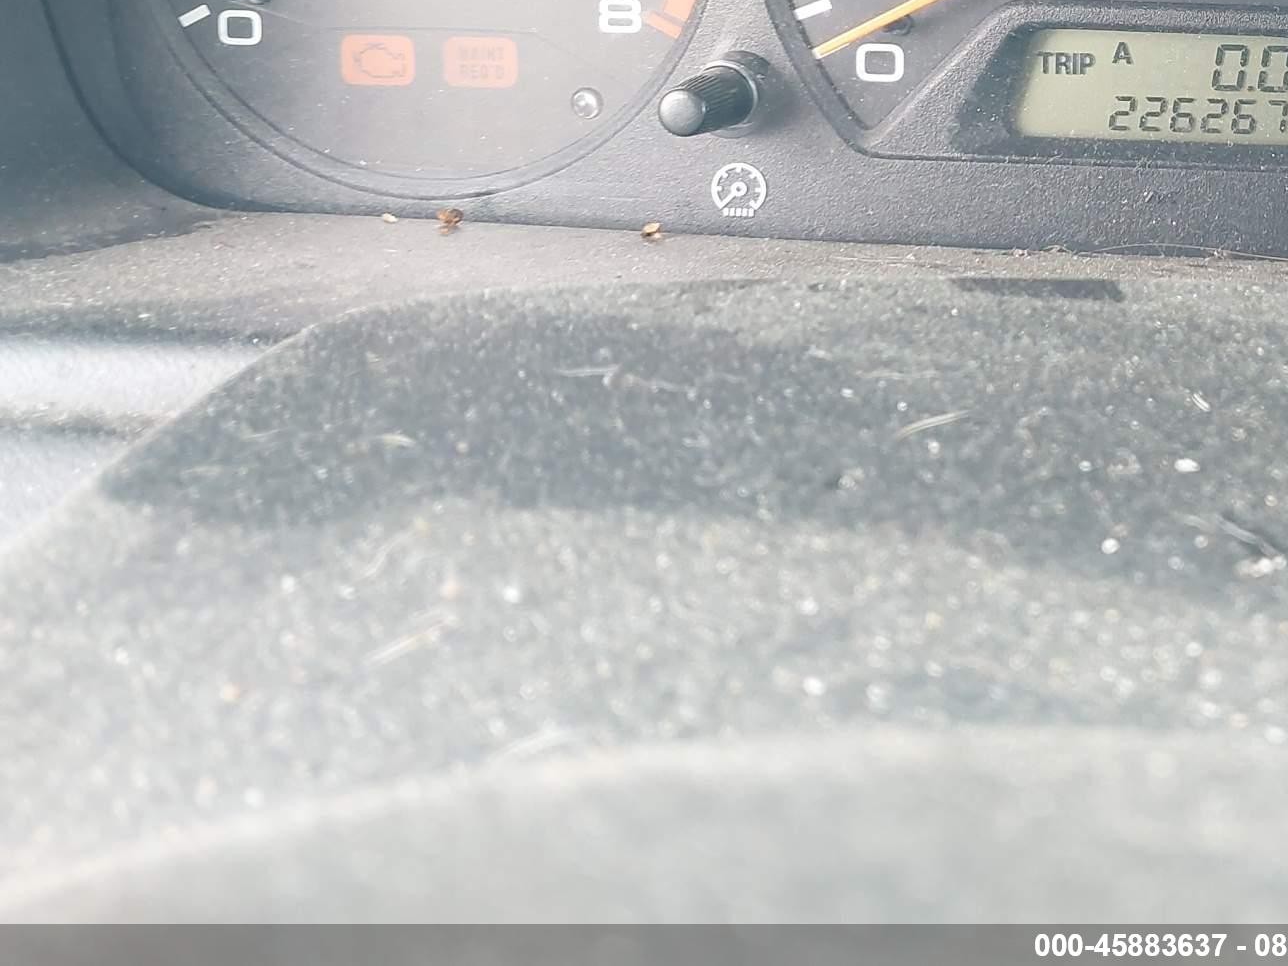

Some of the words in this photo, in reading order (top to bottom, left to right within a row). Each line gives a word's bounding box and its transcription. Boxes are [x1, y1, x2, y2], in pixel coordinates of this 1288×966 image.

[217, 9, 262, 45] 0
[856, 43, 904, 82] 0
[1039, 52, 1096, 76] TRIP
[1112, 42, 1133, 65] A
